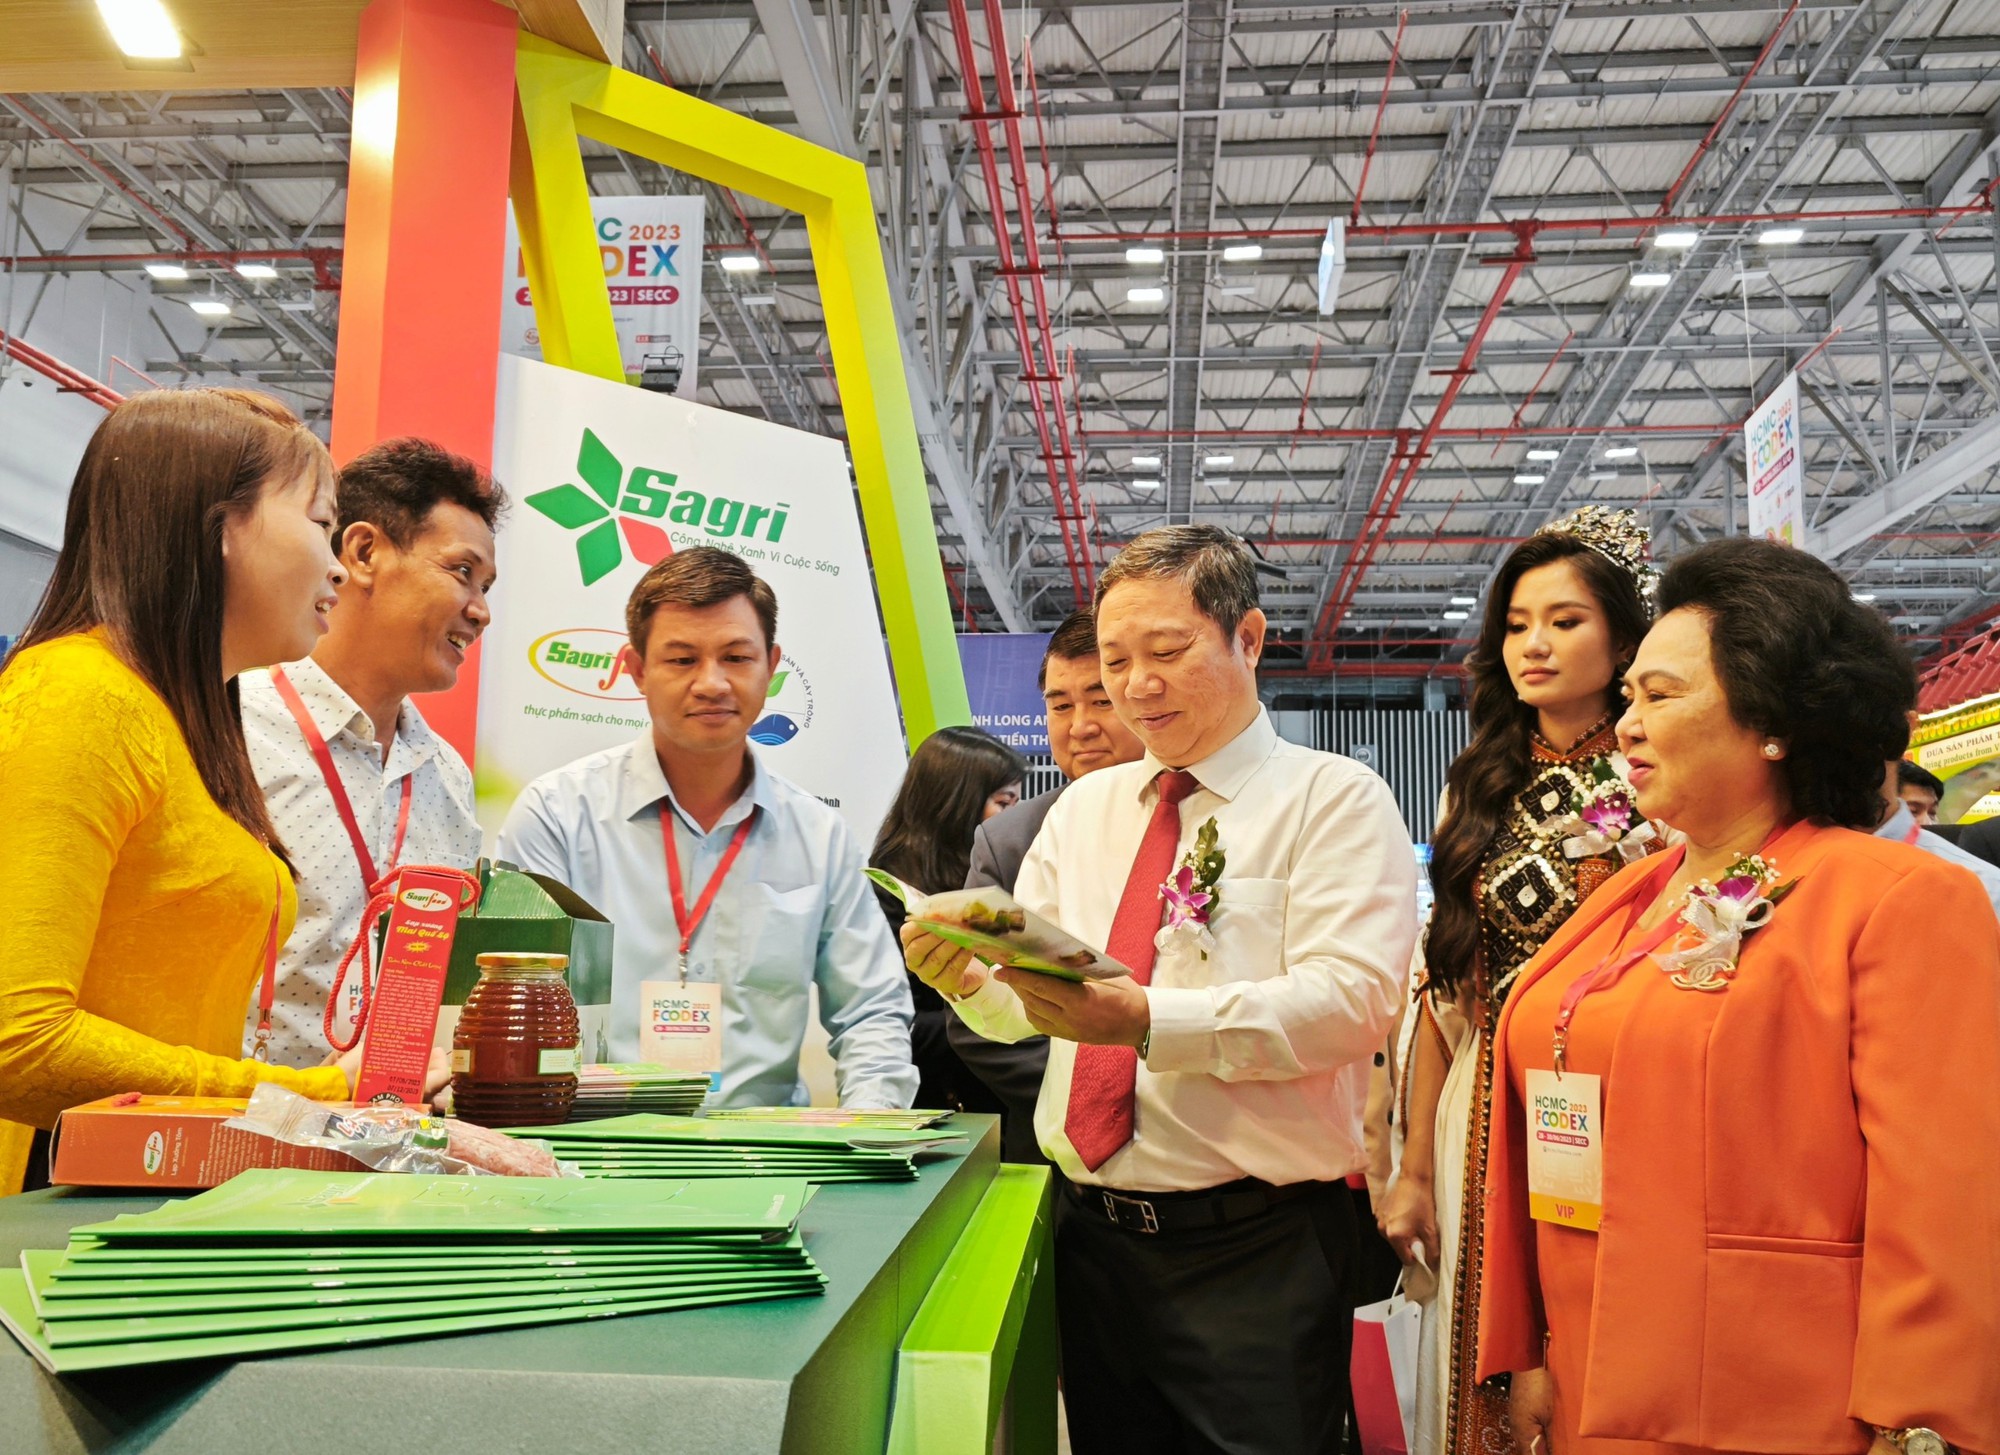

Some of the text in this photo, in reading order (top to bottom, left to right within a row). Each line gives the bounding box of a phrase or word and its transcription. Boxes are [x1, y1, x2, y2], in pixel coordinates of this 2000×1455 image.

[629, 224, 681, 241] 2023
[637, 289, 671, 302] SECC
[1752, 409, 1776, 446] HCMC
[1753, 414, 1793, 475] FCODEX
[619, 466, 790, 544] Sagri
[670, 531, 701, 547] Công
[738, 544, 766, 560] Xanh
[784, 554, 812, 570] Cuộc
[815, 560, 841, 577] Sống
[523, 704, 548, 720] thực
[548, 707, 580, 720] phẩm
[581, 712, 604, 725] sạch
[605, 715, 624, 726] cho
[625, 718, 644, 730] mọi
[994, 715, 1031, 726] LONG
[1943, 752, 1974, 765] products
[1975, 746, 1993, 756] from
[653, 1000, 691, 1009] HCMC
[653, 1010, 710, 1022] FCODEX
[1535, 1095, 1588, 1113] HCMC 2023
[1535, 1110, 1588, 1132] FCODEX
[1556, 1204, 1574, 1219] VIP
